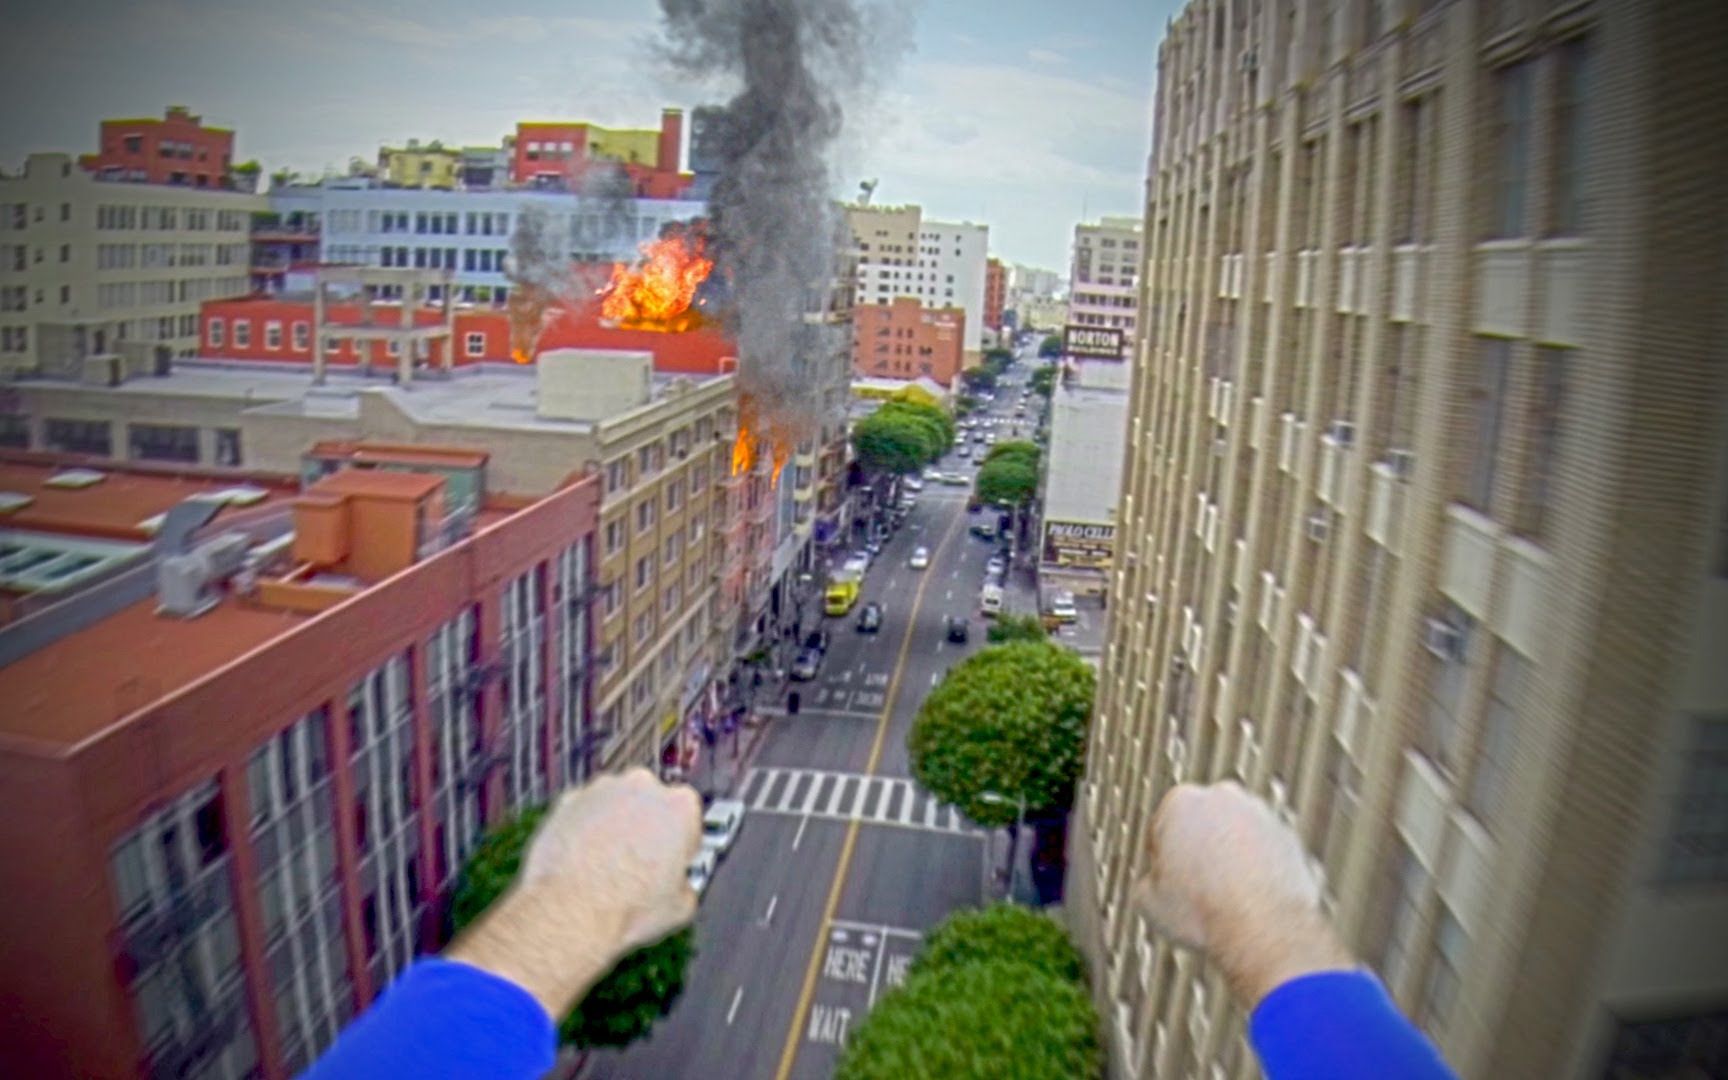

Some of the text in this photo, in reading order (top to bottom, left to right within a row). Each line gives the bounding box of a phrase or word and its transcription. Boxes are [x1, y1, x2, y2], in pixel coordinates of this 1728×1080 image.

[1069, 330, 1119, 346] NORTON
[824, 946, 871, 984] HERE
[886, 954, 912, 988] HE
[807, 1004, 852, 1047] WAIT
